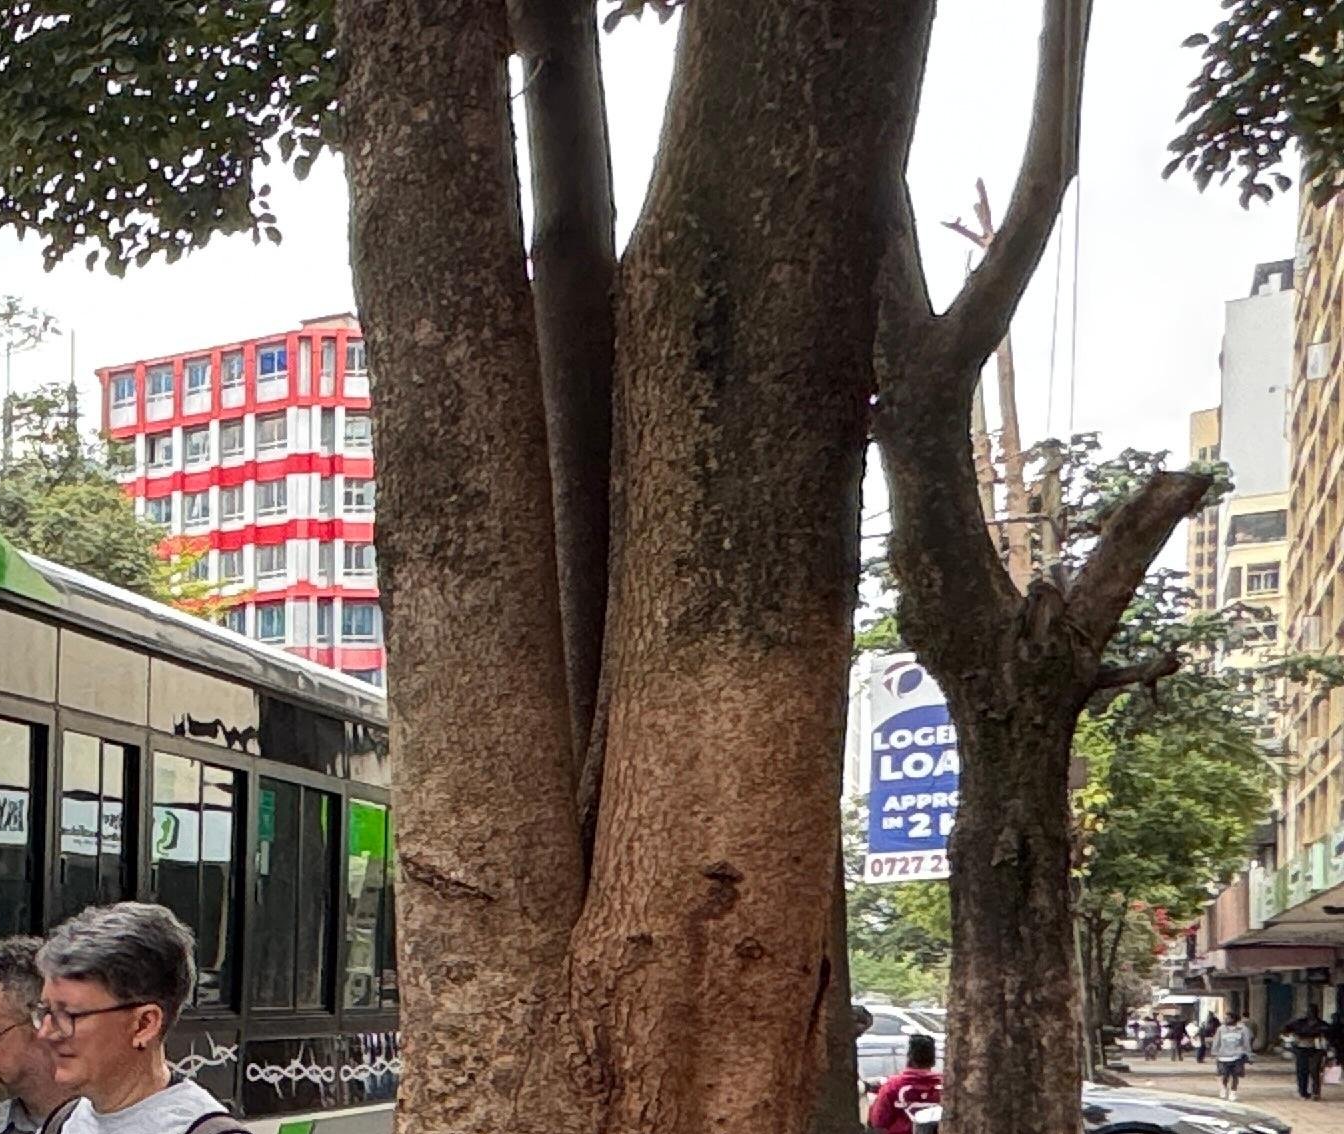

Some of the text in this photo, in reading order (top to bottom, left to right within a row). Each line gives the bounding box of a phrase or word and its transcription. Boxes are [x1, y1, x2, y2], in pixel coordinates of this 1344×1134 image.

[880, 749, 959, 781] LOA
[908, 812, 932, 838] 2
[870, 856, 924, 878] 0727
